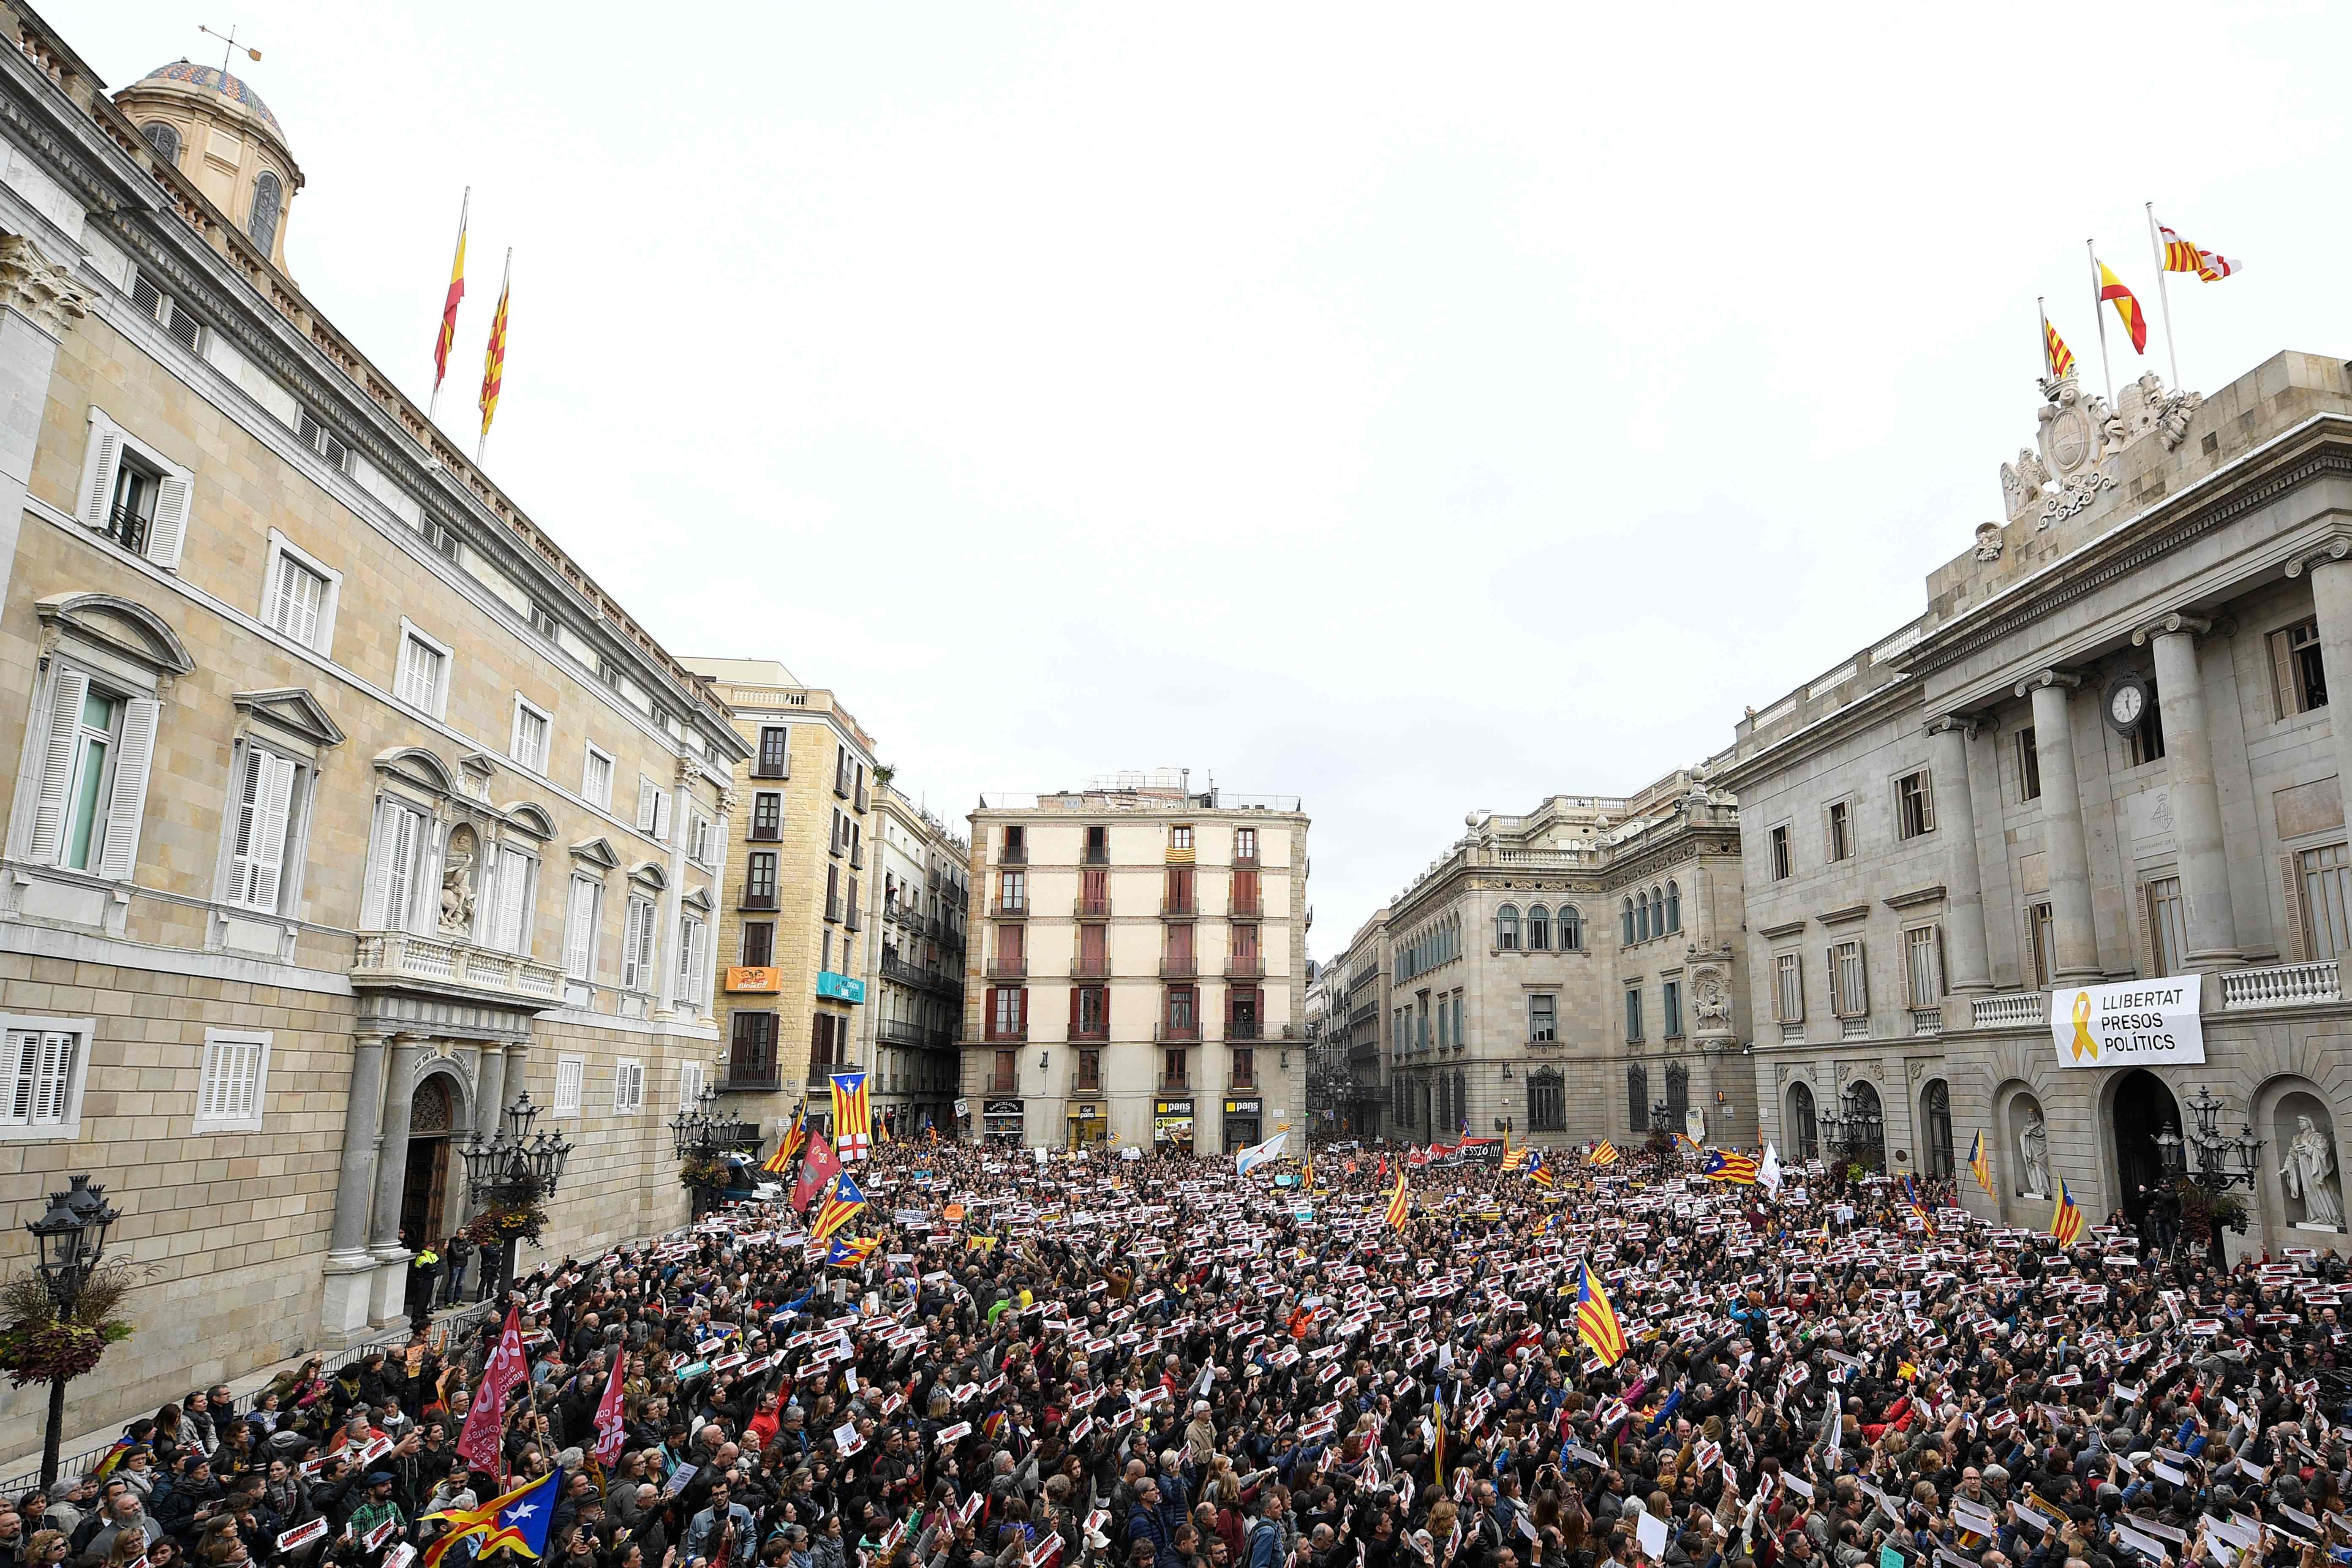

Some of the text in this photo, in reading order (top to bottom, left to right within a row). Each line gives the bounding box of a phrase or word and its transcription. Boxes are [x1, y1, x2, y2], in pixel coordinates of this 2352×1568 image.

[2102, 989, 2183, 1010] LLIBERTAT
[2102, 1013, 2163, 1032] PRESOS
[2105, 1032, 2175, 1053] POLÍTICS
[989, 1101, 1019, 1111] BARCELONA
[1168, 1102, 1191, 1113] pans
[1236, 1101, 1259, 1112] pans
[681, 1361, 705, 1375] LLIBERTAT
